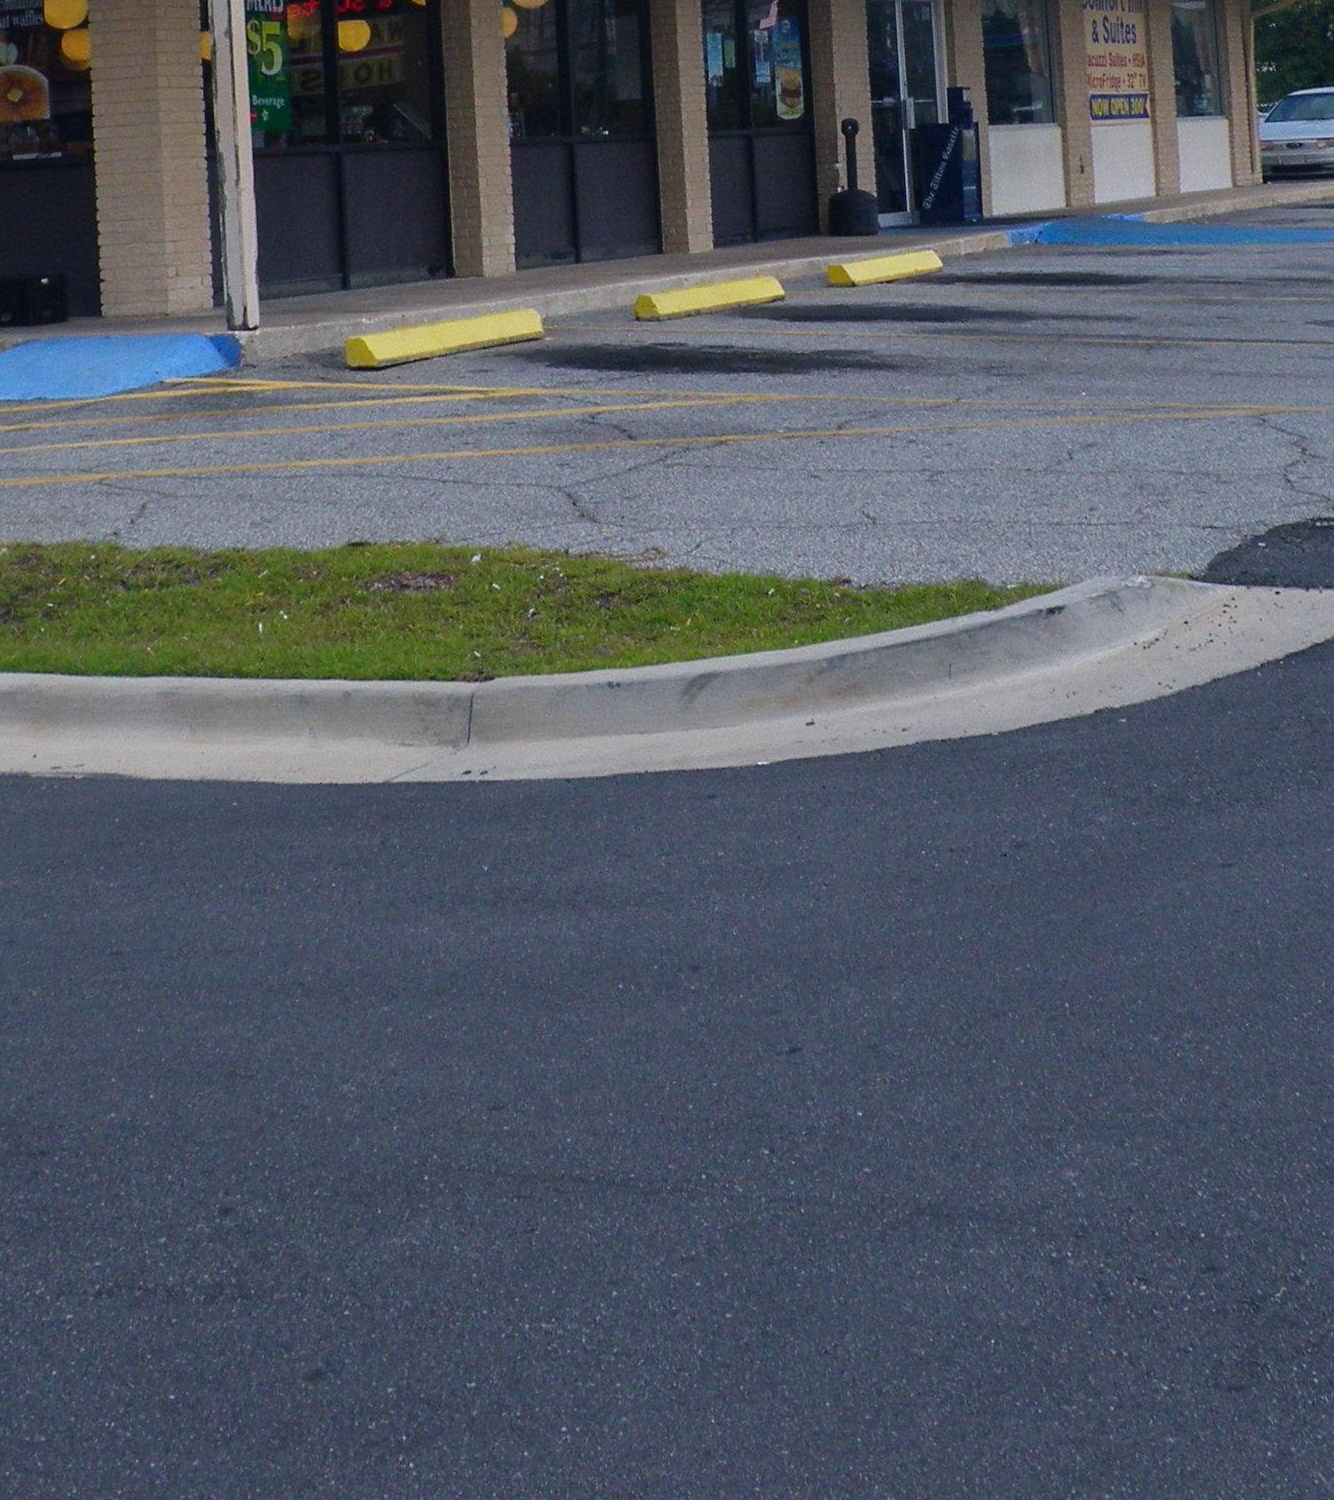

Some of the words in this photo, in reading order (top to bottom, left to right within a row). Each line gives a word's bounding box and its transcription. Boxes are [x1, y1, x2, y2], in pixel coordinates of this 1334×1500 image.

[1091, 19, 1099, 43] &
[1102, 16, 1137, 44] Suites
[252, 94, 285, 109] Beverage
